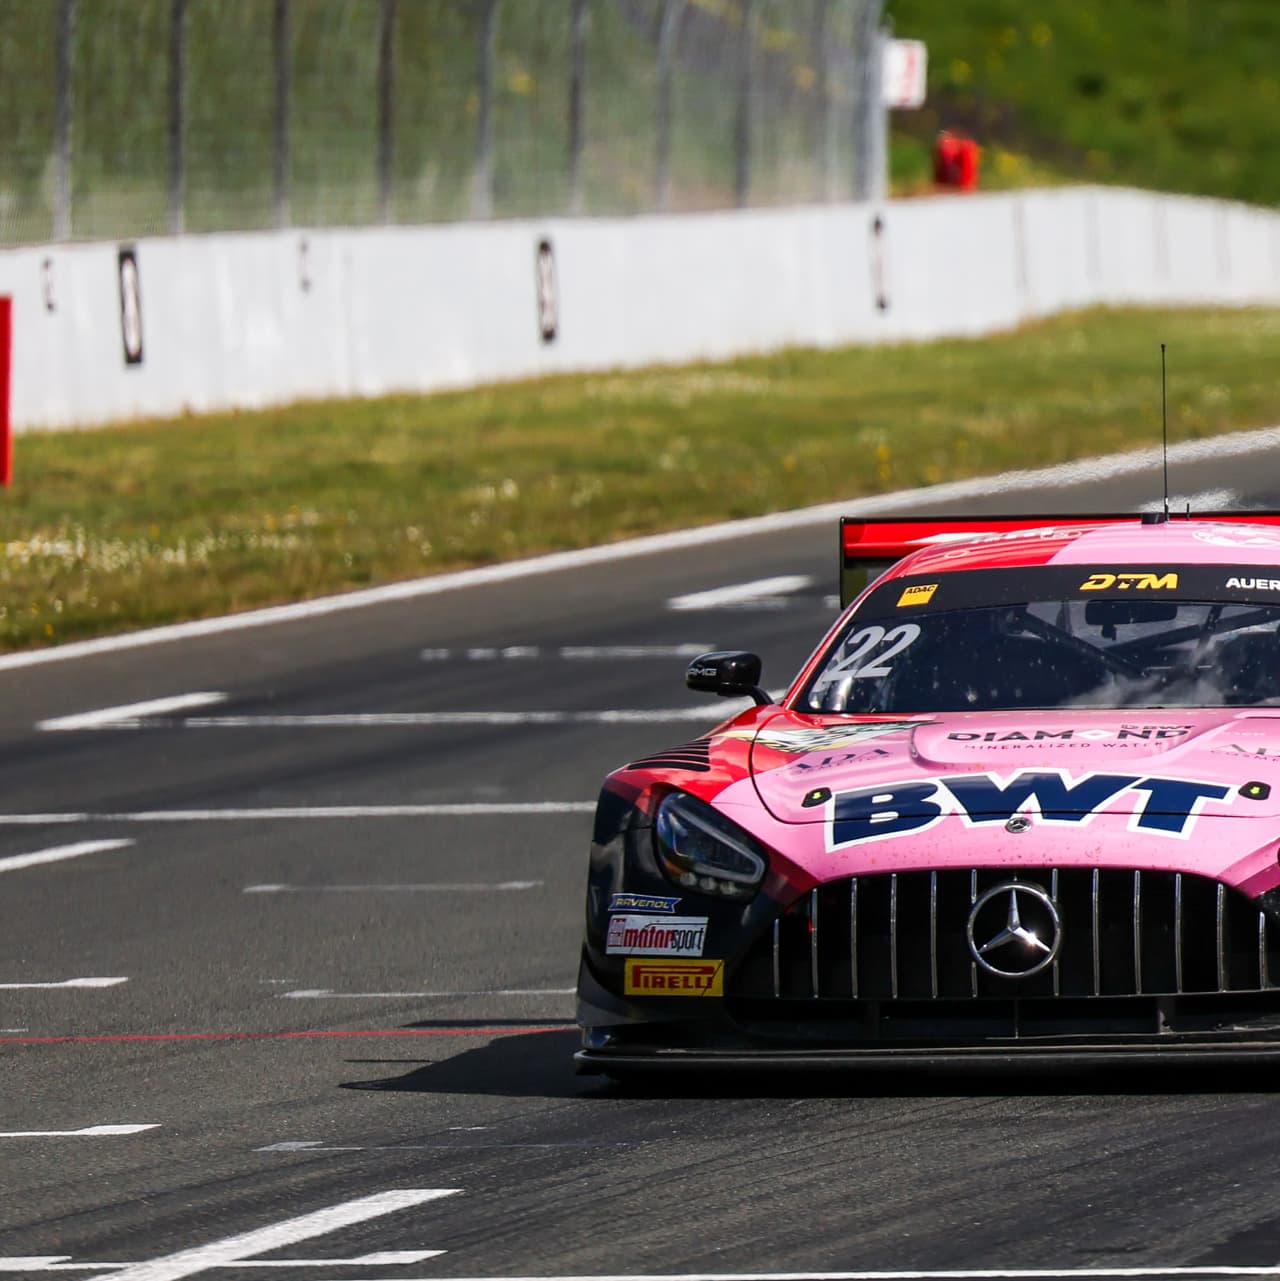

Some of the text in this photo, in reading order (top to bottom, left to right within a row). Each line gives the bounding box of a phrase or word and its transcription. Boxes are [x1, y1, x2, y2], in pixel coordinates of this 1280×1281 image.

[905, 584, 936, 596] ADAC
[1080, 573, 1178, 591] DTM
[821, 623, 921, 682] 22
[827, 768, 1238, 850] BWT
[615, 897, 670, 909] RAVENOL
[624, 925, 705, 952] motorsport
[632, 965, 716, 989] PIRELLI
